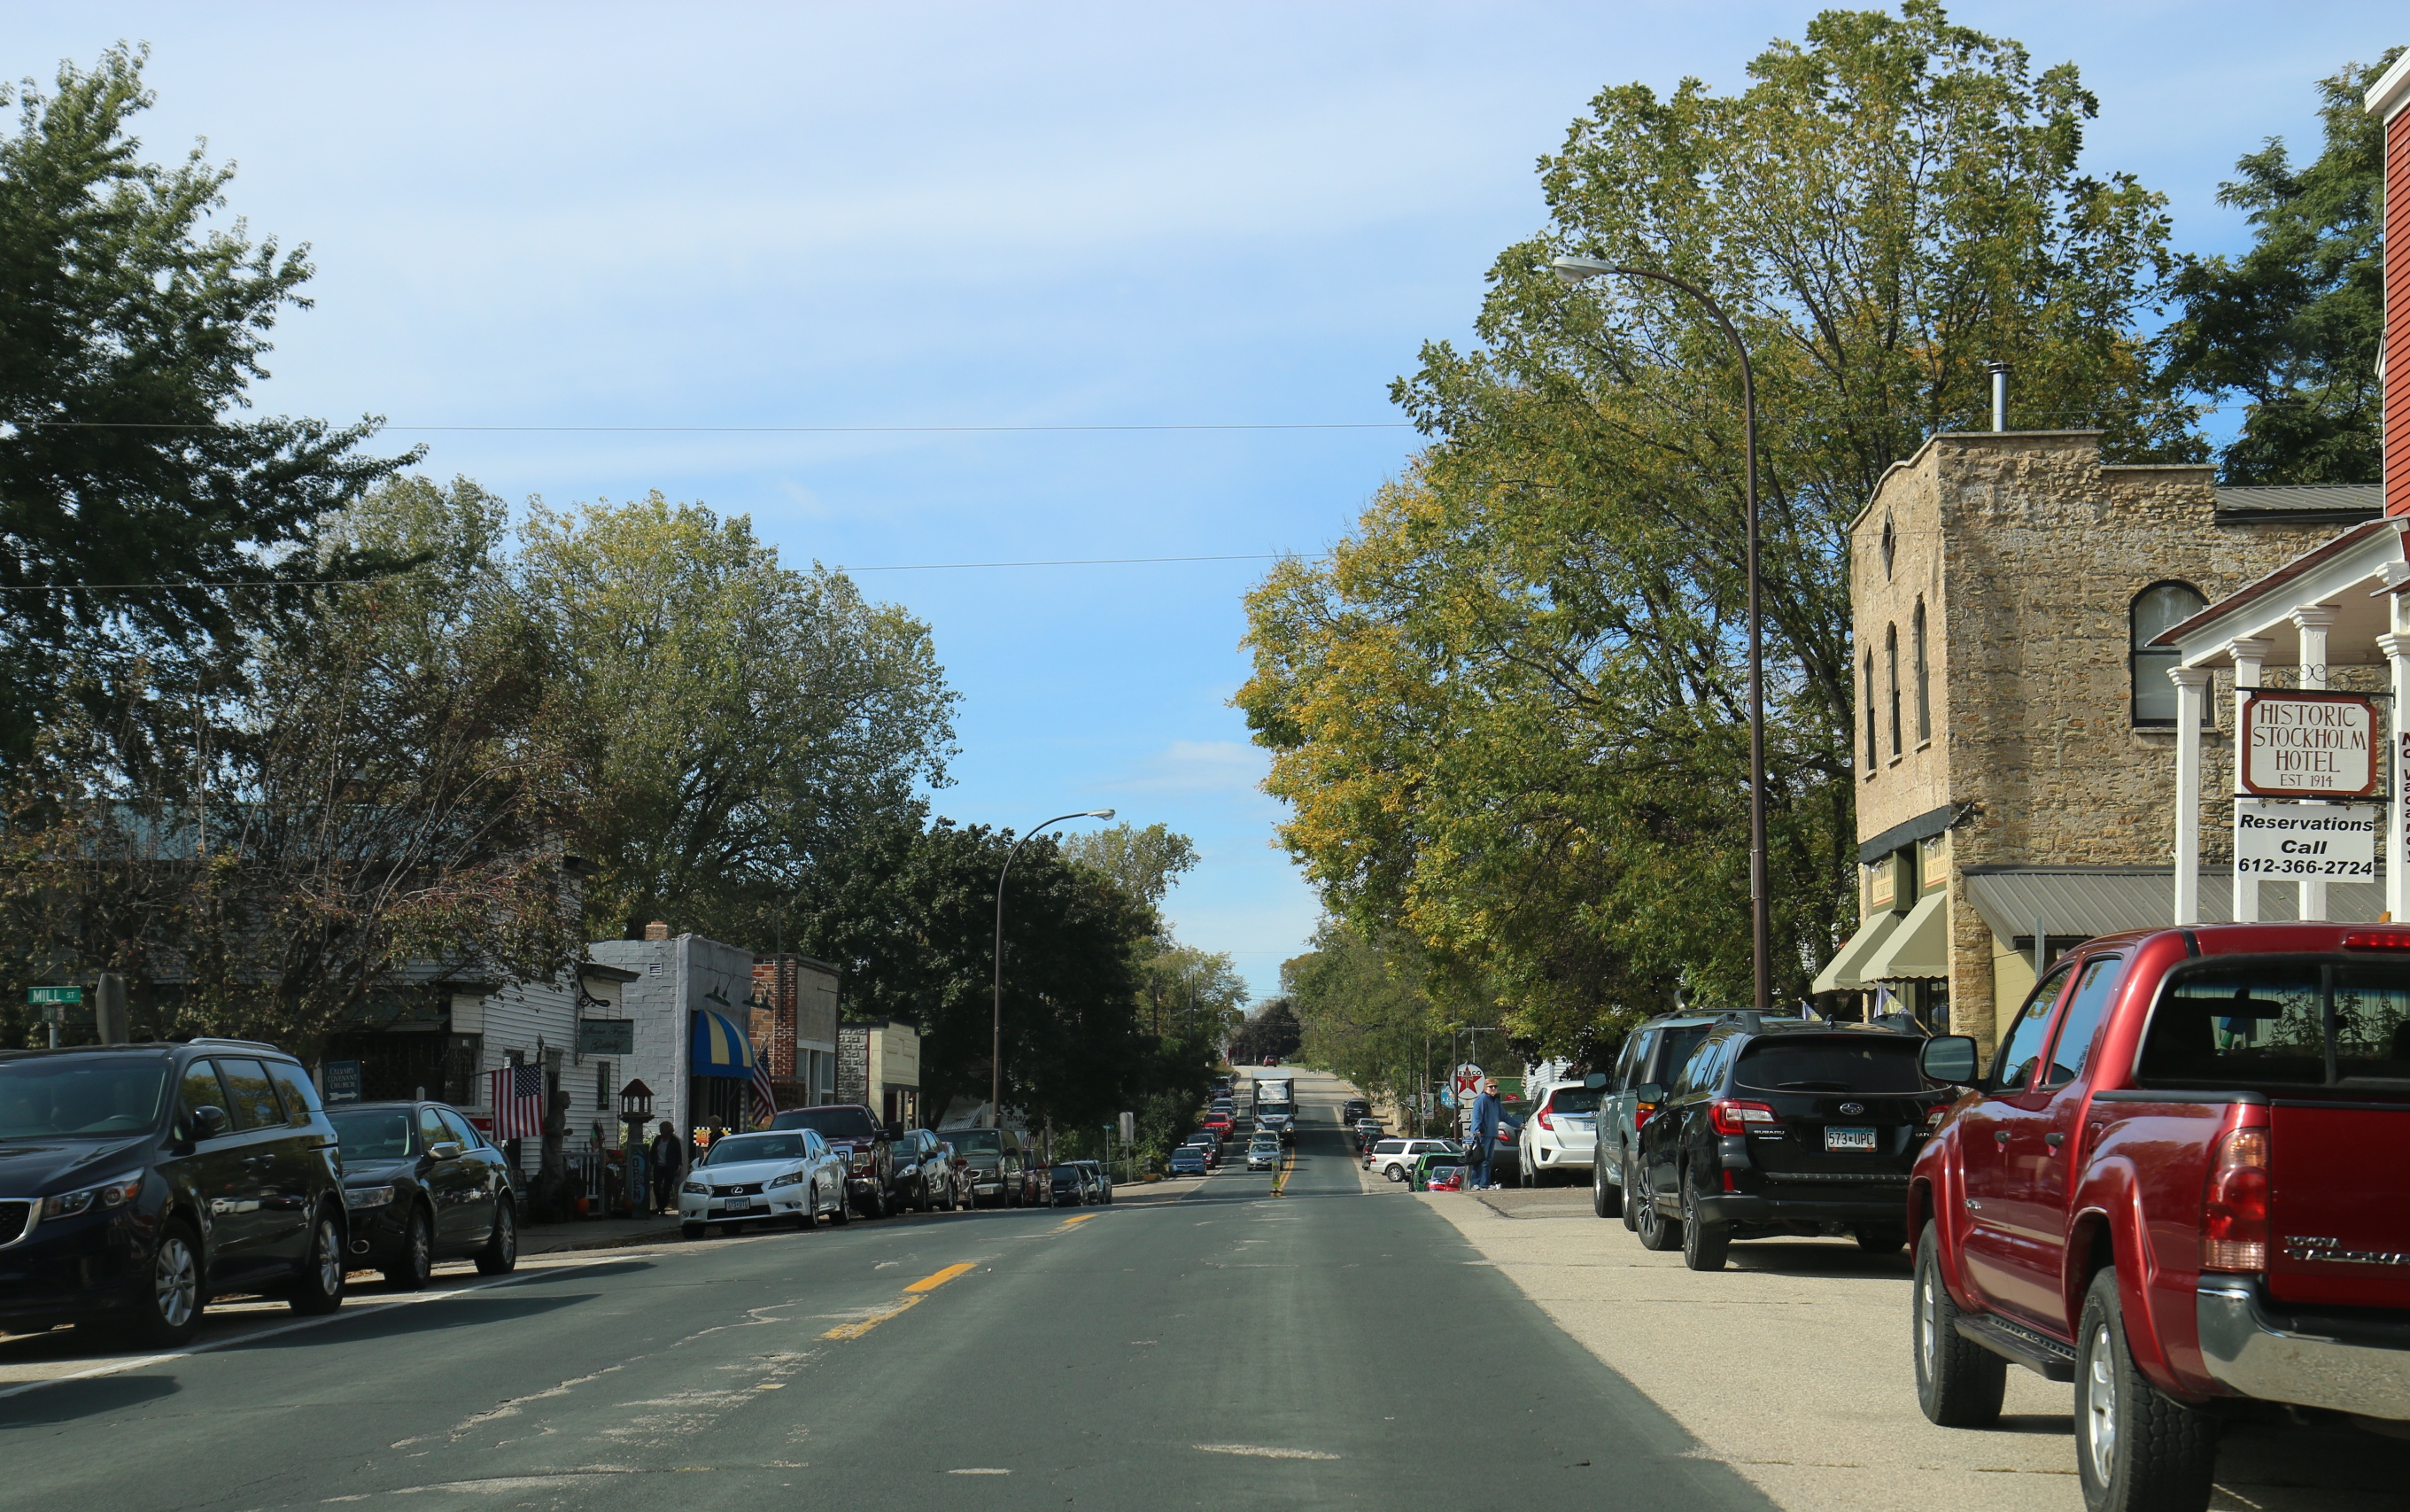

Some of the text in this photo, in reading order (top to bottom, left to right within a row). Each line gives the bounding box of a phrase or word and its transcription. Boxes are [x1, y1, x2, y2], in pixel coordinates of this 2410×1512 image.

[2260, 703, 2357, 727] HISTORIC
[2252, 726, 2367, 750] STOCKHOLM
[2275, 750, 2341, 772] HOTEL
[2280, 774, 2334, 787] EST 1914
[2239, 814, 2374, 832] Reservations
[2281, 840, 2328, 855] Call
[2238, 857, 2373, 875] 612-366-2724
[33, 989, 61, 1002] MILL
[328, 1074, 358, 1083] COVENANT
[329, 1067, 354, 1076] CALVARY
[1828, 1133, 1873, 1145] 573 UPC
[632, 1157, 641, 1200] OPEN
[2285, 1236, 2341, 1248] TOYOTA
